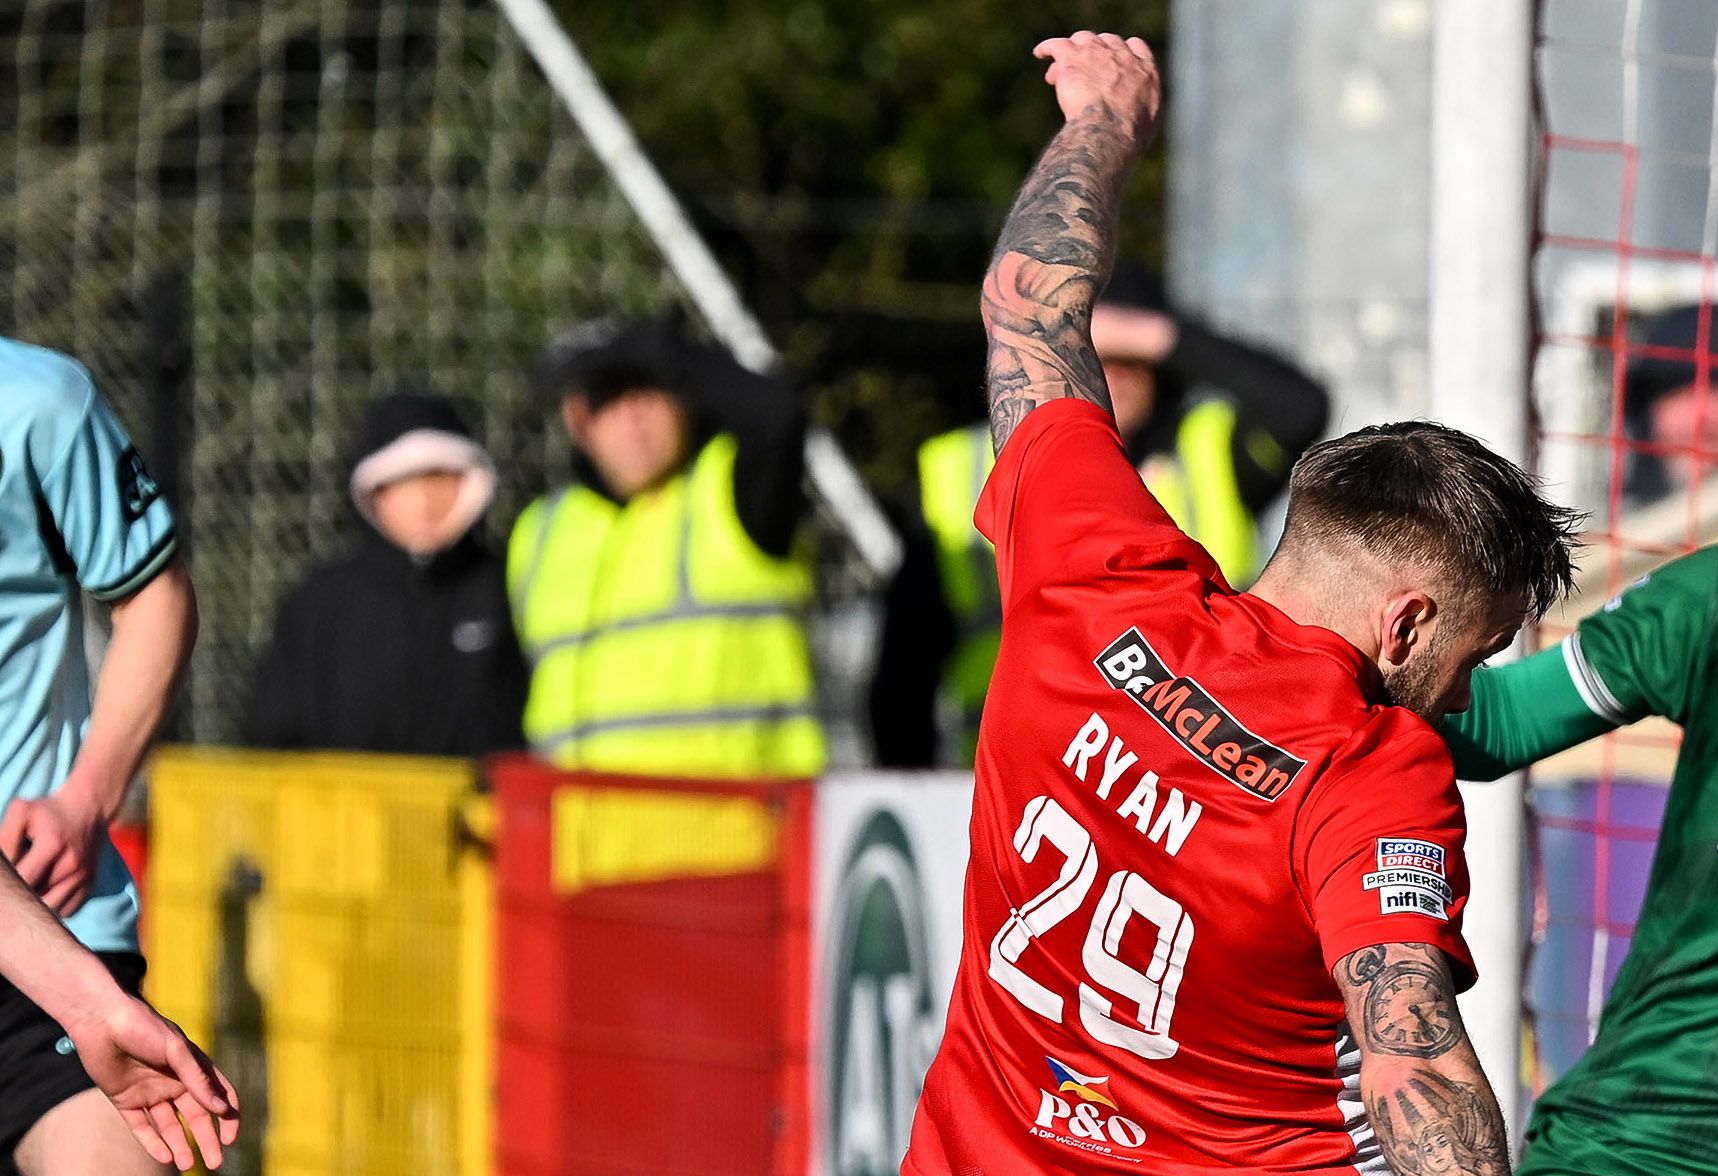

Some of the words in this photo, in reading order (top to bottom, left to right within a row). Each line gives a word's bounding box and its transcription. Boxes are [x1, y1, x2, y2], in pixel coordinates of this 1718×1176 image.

[1061, 712, 1202, 857] RYAN
[1384, 843, 1440, 859] SPORTS
[1386, 855, 1439, 871] DIRECT
[1366, 872, 1451, 900] PREMIERSH
[1387, 892, 1418, 907] nifl
[988, 795, 1195, 1060] 29
[1034, 1088, 1147, 1148] P&O
[1029, 1126, 1038, 1136] A
[1038, 1130, 1056, 1139] DP
